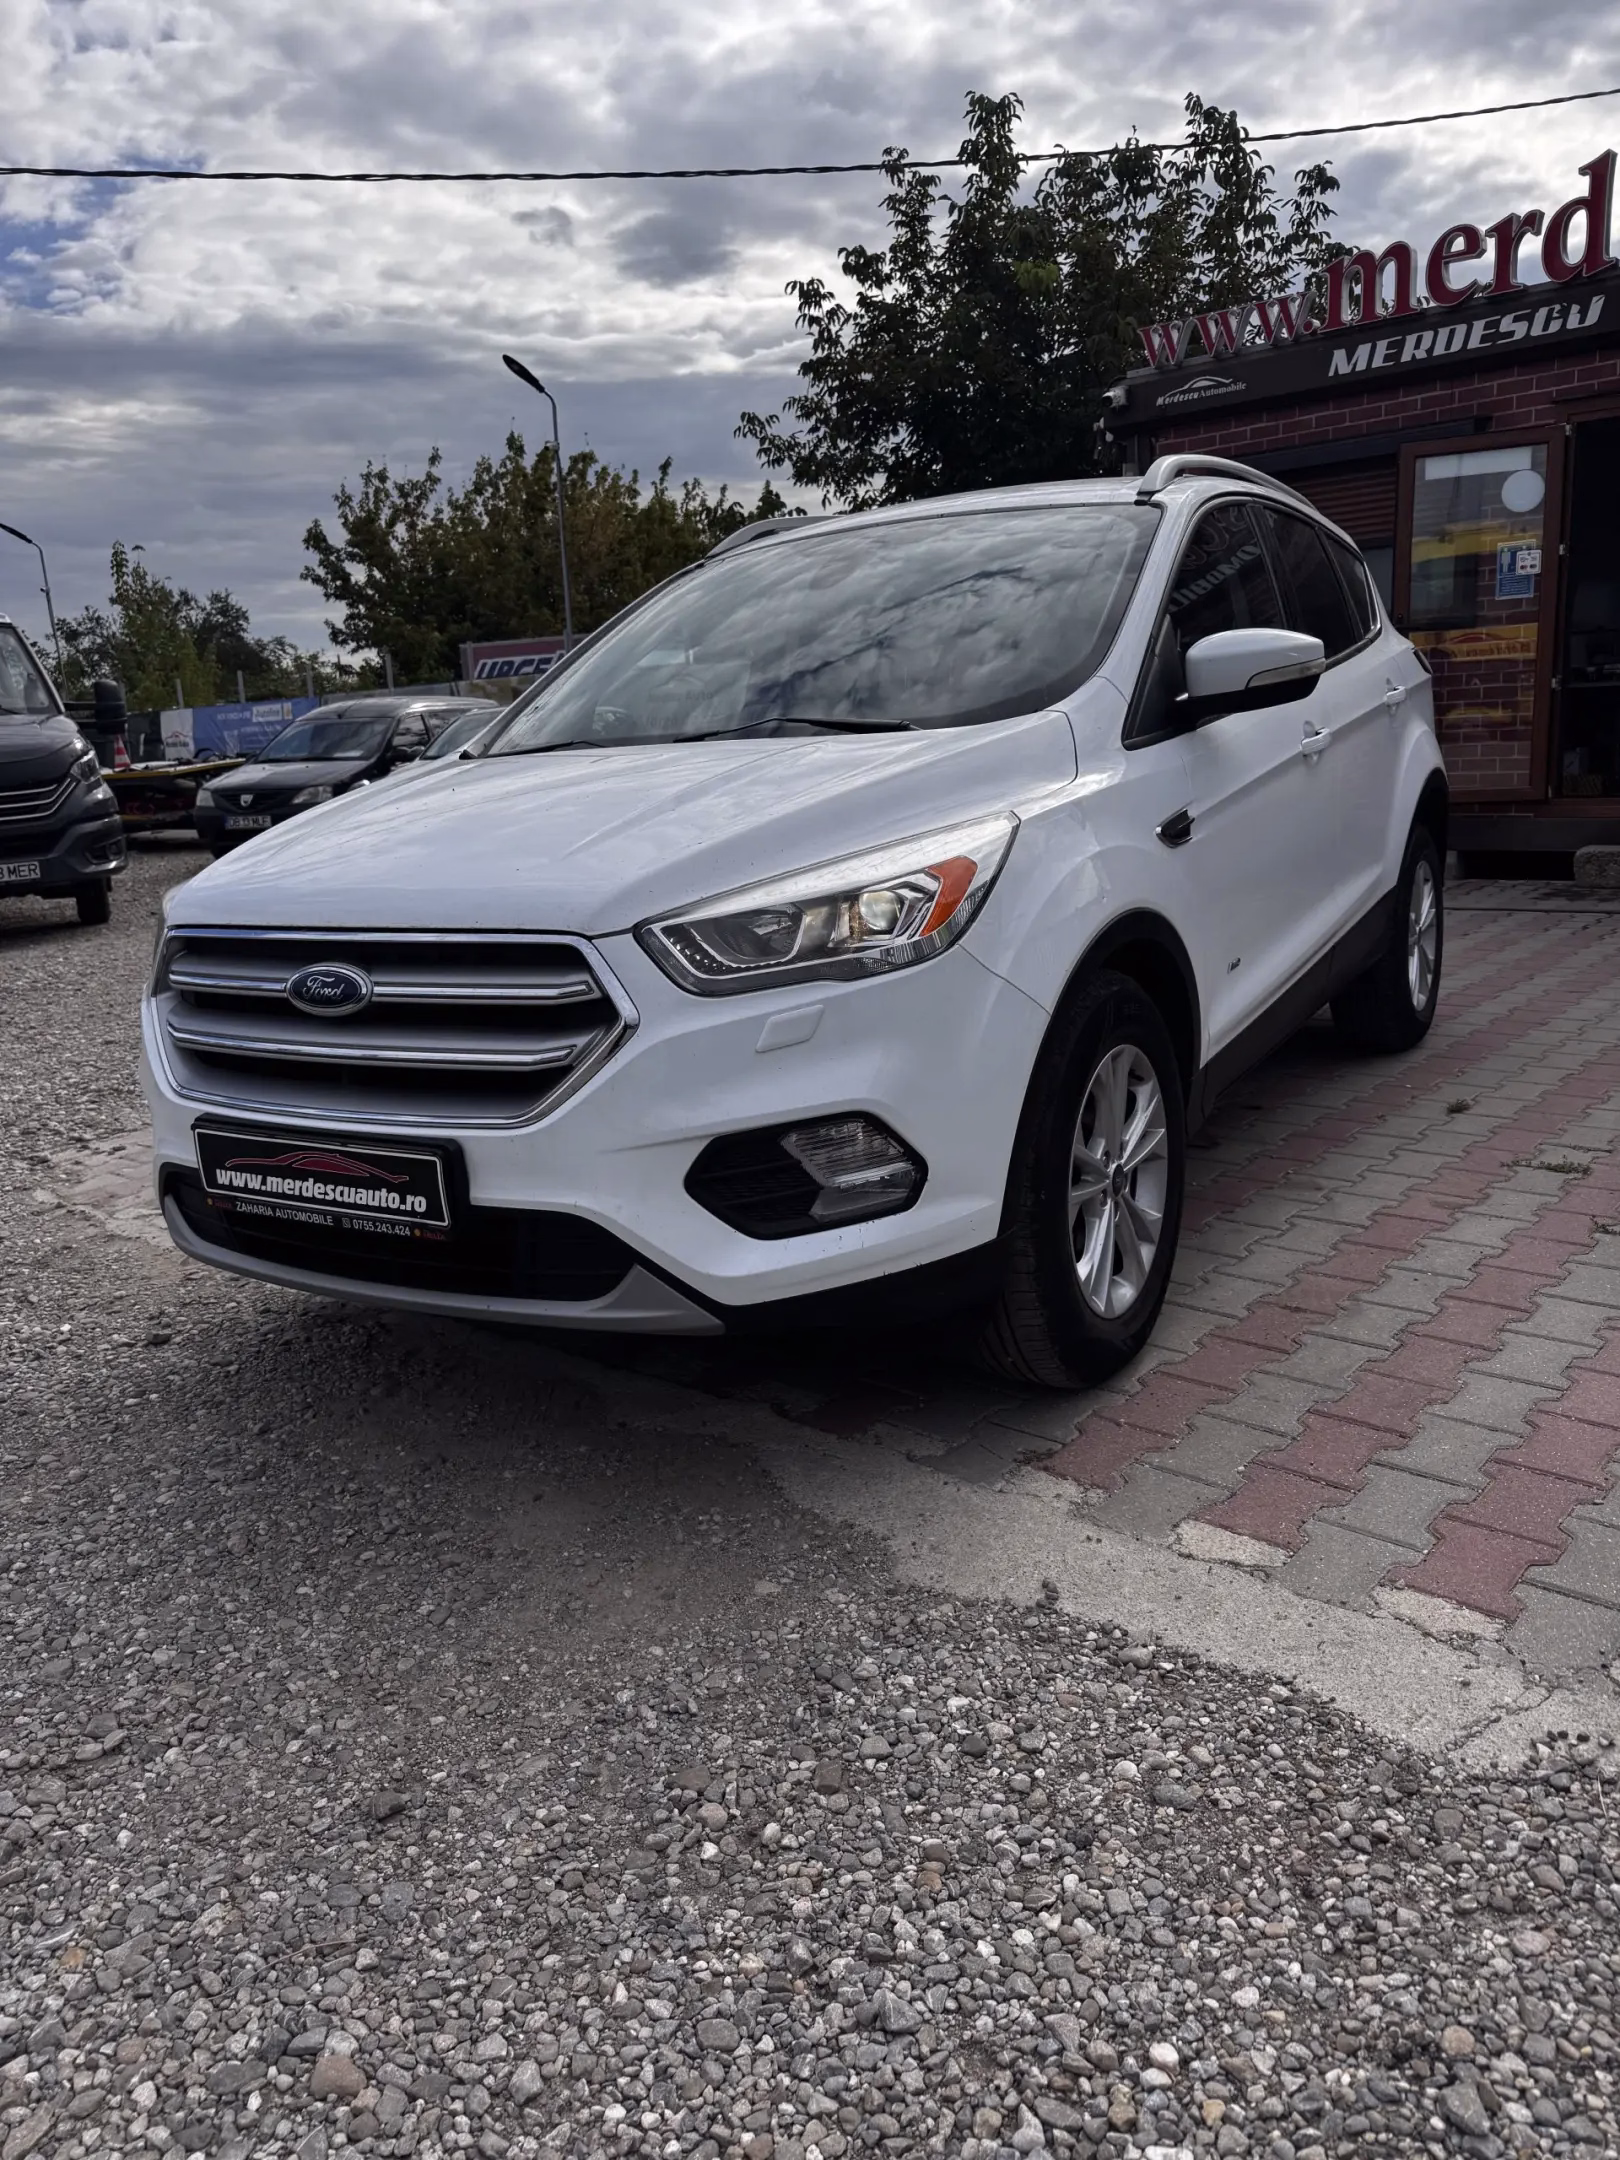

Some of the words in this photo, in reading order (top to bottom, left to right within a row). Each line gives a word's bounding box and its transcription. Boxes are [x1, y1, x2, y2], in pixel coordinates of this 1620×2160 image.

[1328, 294, 1605, 377] MERDESCU
[7, 863, 38, 879] MER
[303, 975, 345, 999] Ford
[216, 1168, 427, 1213] www.merdescuauto.ro
[236, 1201, 274, 1217] ZAHARIA
[276, 1208, 334, 1226] AUTOMOBILE
[353, 1219, 411, 1236] 0755.243.424
